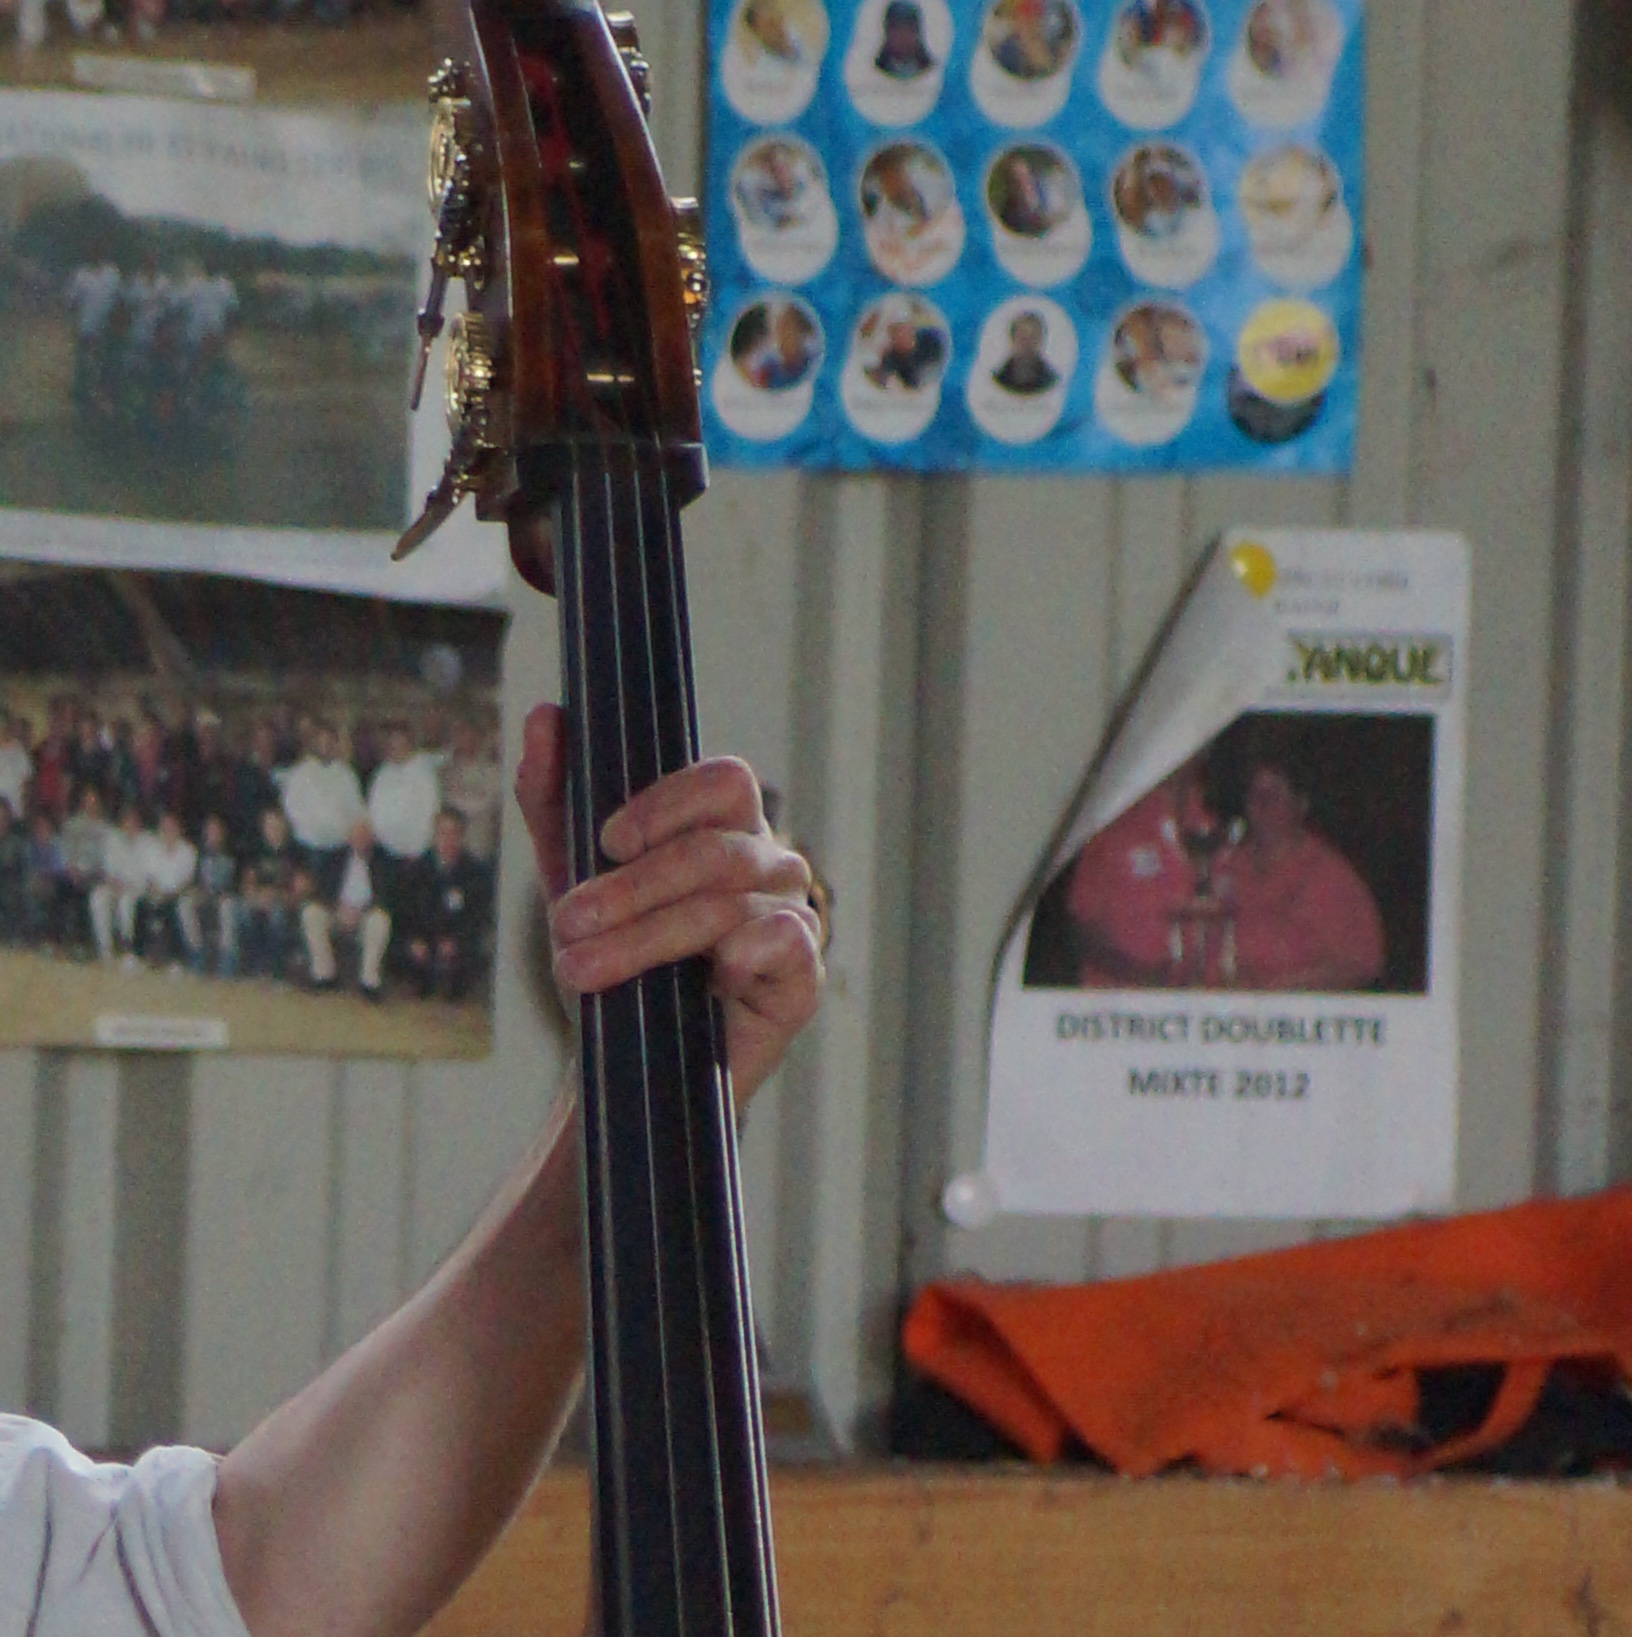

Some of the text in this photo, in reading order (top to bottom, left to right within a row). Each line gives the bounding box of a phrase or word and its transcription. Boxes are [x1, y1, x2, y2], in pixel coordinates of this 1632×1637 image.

[1055, 1012, 1385, 1044] DISTRICT DOUBLETTE
[1127, 1067, 1311, 1098] MIXTE 2012
